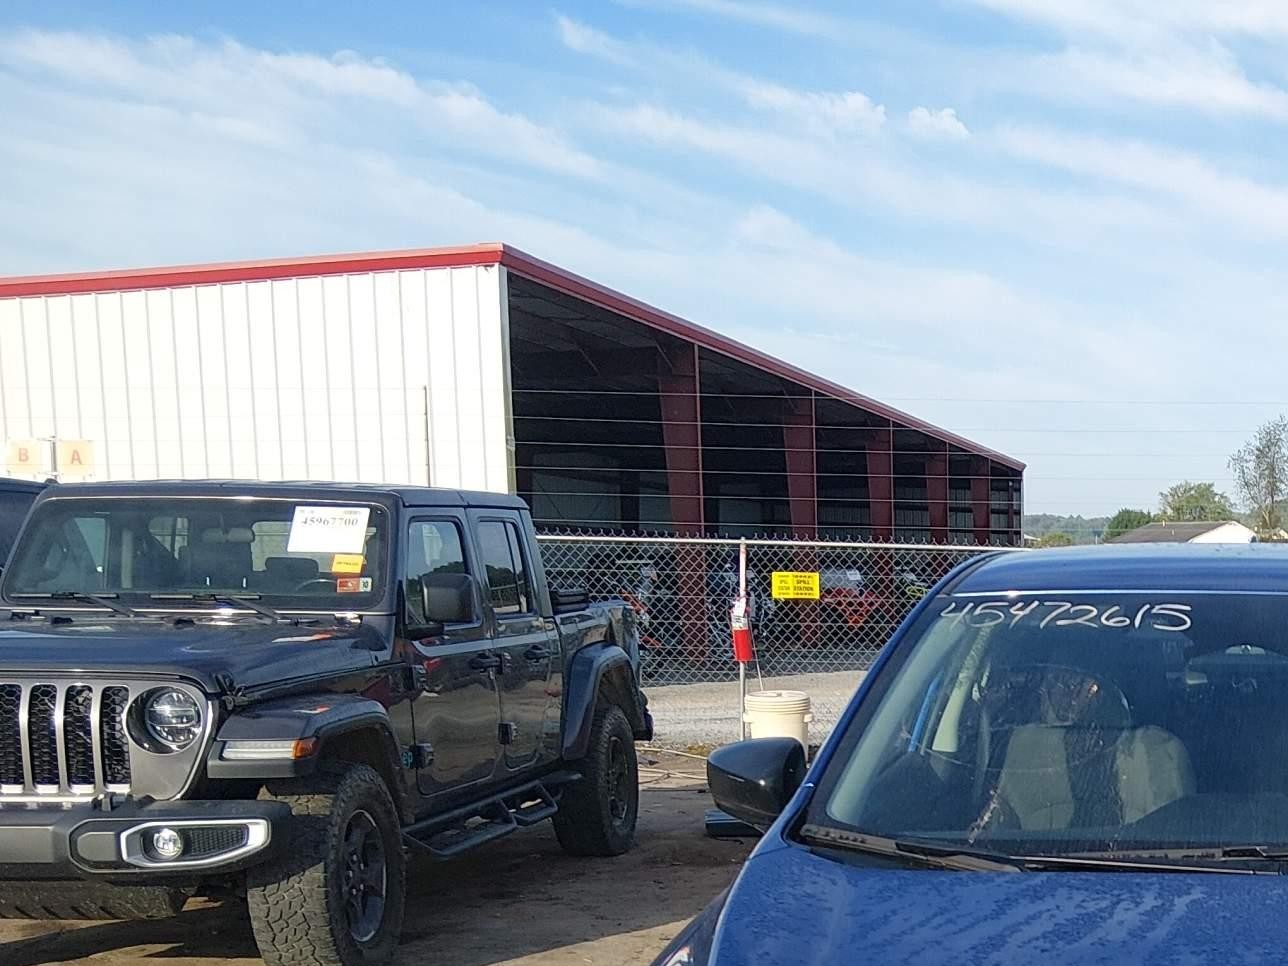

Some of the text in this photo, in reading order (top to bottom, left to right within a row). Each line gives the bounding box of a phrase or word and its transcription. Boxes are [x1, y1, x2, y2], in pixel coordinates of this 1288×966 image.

[18, 447, 29, 462] B
[71, 448, 82, 464] A
[940, 600, 1192, 631] 45472615
